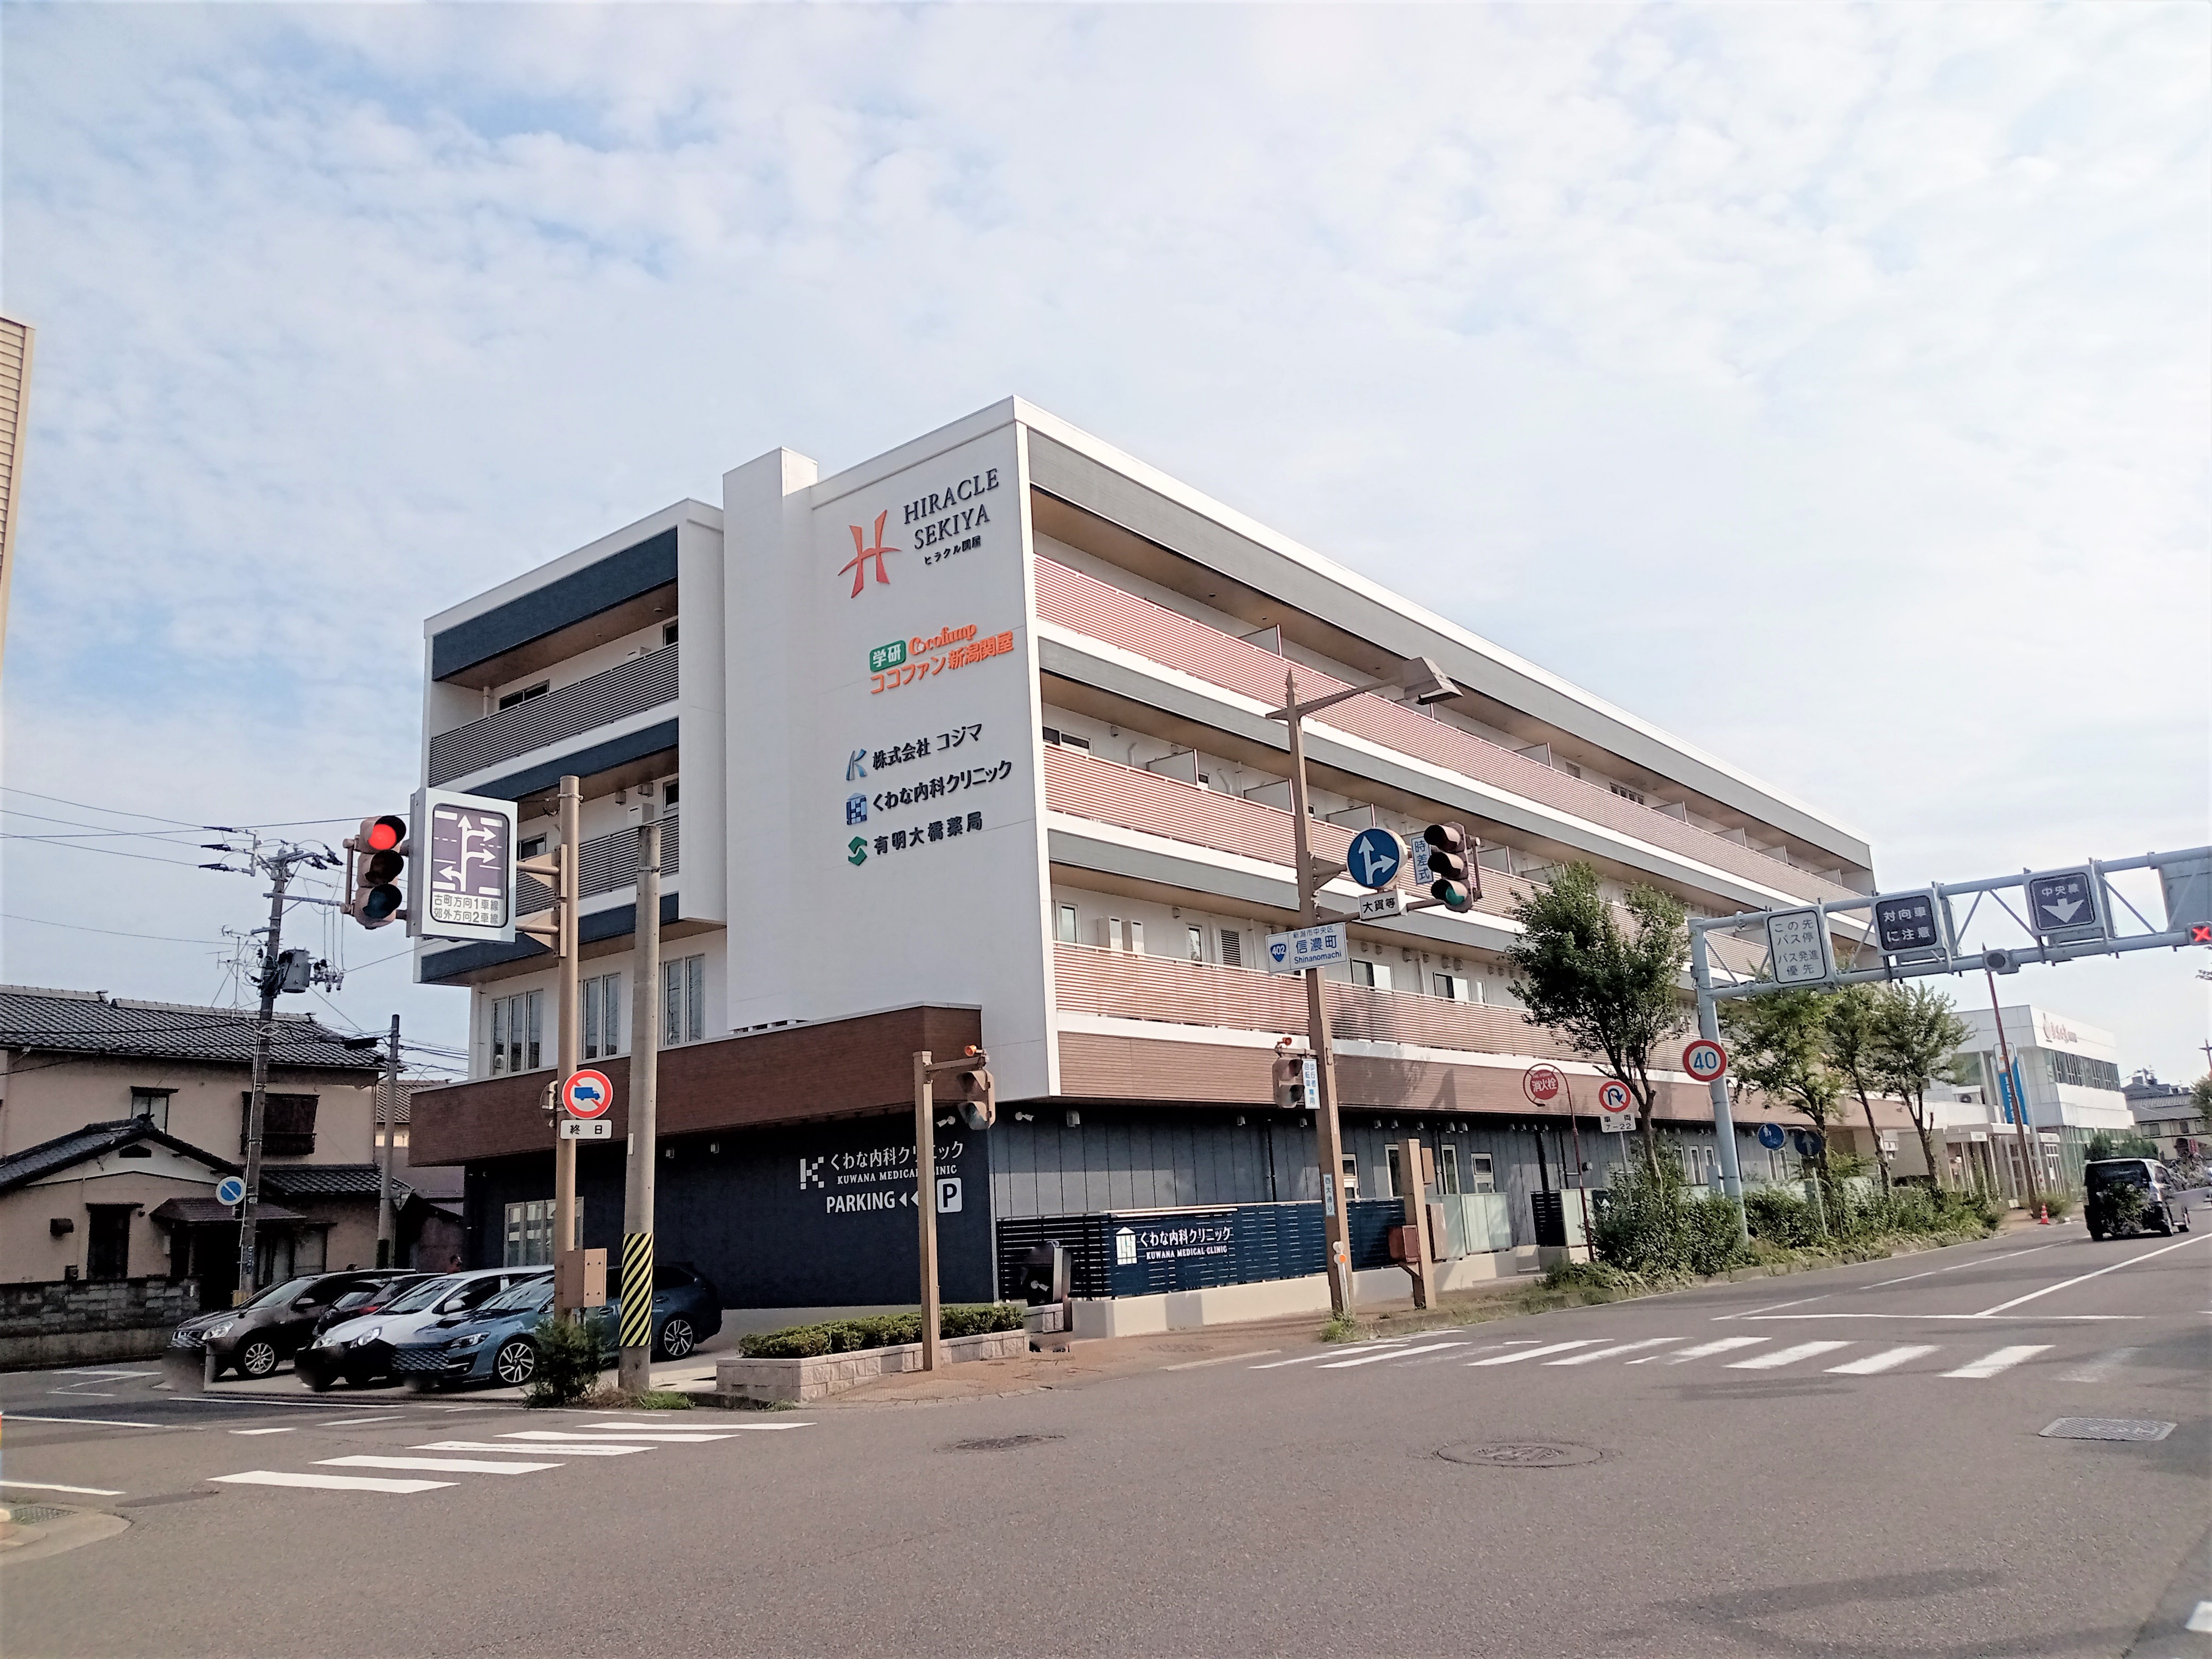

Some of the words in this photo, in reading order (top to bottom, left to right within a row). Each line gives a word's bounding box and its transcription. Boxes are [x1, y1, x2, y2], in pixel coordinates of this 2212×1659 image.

[904, 468, 1000, 524] HIRACLE
[914, 504, 990, 550] SEKIYA
[924, 535, 982, 565] ヒラクル関屋
[870, 630, 1013, 694] ココファン新潟関屋
[873, 643, 902, 668] 学研
[873, 738, 931, 770] 株式会社
[936, 724, 983, 751] コジマ
[873, 760, 1012, 811] くわな内科クリニック
[874, 811, 983, 855] 有明大橋薬局
[1414, 840, 1430, 880] 時差式
[434, 894, 499, 911] 古町方向1車線
[1362, 898, 1396, 914] 大貨等
[433, 907, 498, 924] 郊外方向2車線
[1883, 906, 1926, 922] 対向車
[1293, 926, 1334, 939] 新潟市中央区
[1775, 919, 1814, 932] この先
[1778, 932, 1814, 945] バス停
[1887, 926, 1931, 943] に注意
[1272, 945, 1285, 956] 402
[1296, 935, 1337, 954] 信濃町
[1294, 950, 1342, 965] Shinanomachi
[1778, 950, 1819, 963] バス発進
[1787, 964, 1814, 976] 優先
[1694, 1051, 1717, 1070] 40
[1531, 1077, 1557, 1092] 消火栓
[570, 1124, 602, 1135] 終日
[831, 1141, 963, 1171] くわな内科クック
[837, 1172, 876, 1185] KUWANA
[826, 1191, 895, 1213] PARKING
[943, 1183, 958, 1208] P
[1140, 1226, 1231, 1247] くわな内科クリニック
[1146, 1250, 1175, 1260] KUWANA
[1177, 1246, 1205, 1258] MEDICAL
[1206, 1245, 1228, 1254] CLINIC
